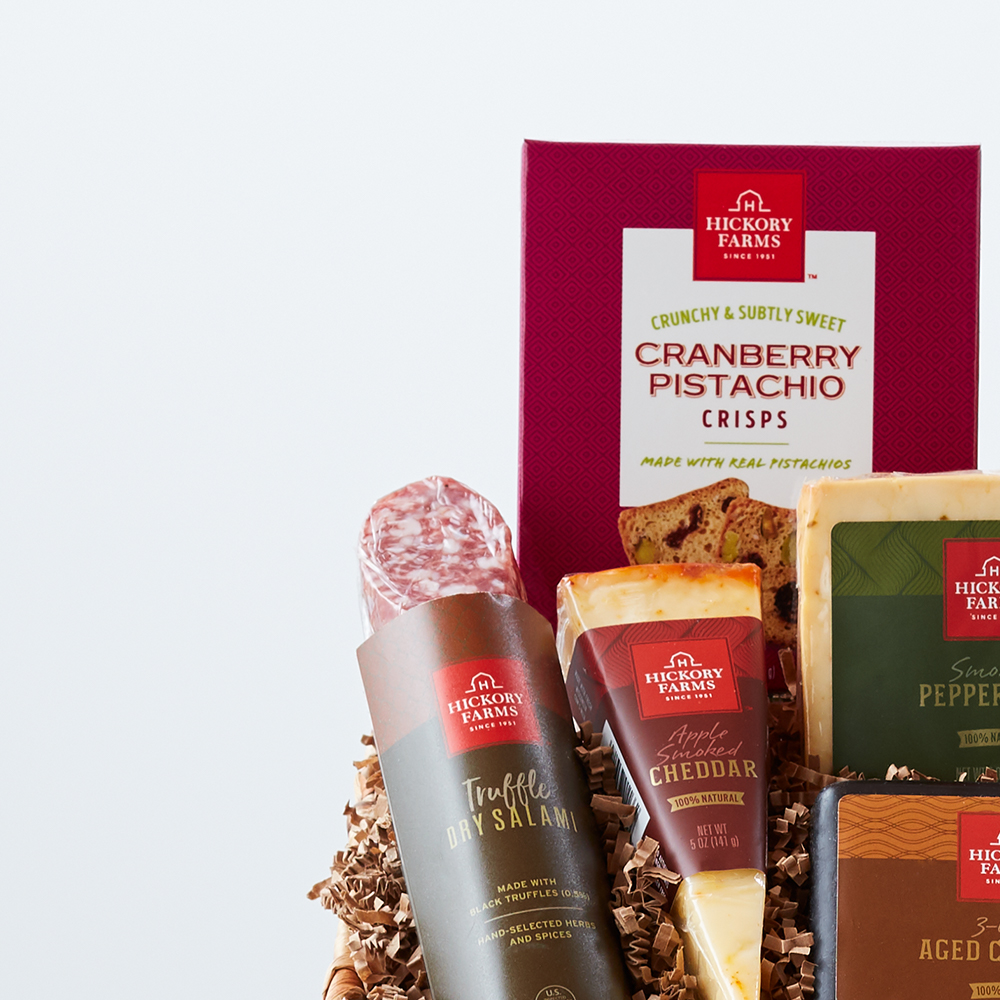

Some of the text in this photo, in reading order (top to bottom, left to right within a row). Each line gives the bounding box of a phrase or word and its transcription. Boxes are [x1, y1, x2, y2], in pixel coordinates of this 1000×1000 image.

[705, 217, 793, 232] HICKORY
[718, 234, 781, 248] FARMS
[651, 305, 846, 333] CRUNCHY & SUBTLY SWEET
[634, 341, 863, 369] CRANBERRY
[649, 372, 847, 400] PISTACHIO
[702, 409, 788, 429] CRISPS
[640, 456, 852, 470] MADE WITH REAL PISTACHIOS
[644, 668, 724, 684] HICKORY
[658, 680, 716, 694] FARMS
[447, 692, 523, 714] HICKORY
[461, 705, 519, 724] FARMS
[469, 722, 495, 732] SINCE
[668, 721, 729, 749] Apple
[964, 732, 989, 745] 100%
[656, 741, 744, 767] Smoked
[649, 759, 758, 787] CHEDDAR
[462, 769, 551, 812] Truffle
[674, 793, 739, 808] 100% NATURAL
[446, 804, 578, 850] DRY SALAMI
[697, 823, 728, 837] NET WT
[689, 838, 696, 851] 5
[697, 836, 710, 849] OZ
[711, 835, 730, 849] (141
[497, 878, 557, 893] MADE WITH
[469, 897, 502, 916] BLACK
[505, 889, 559, 903] TRUFFLES
[478, 919, 596, 946] HAND-SELECTED HERBS
[509, 930, 572, 946] AND SPICES
[919, 938, 981, 961] AGED
[976, 985, 1000, 996] 100%
